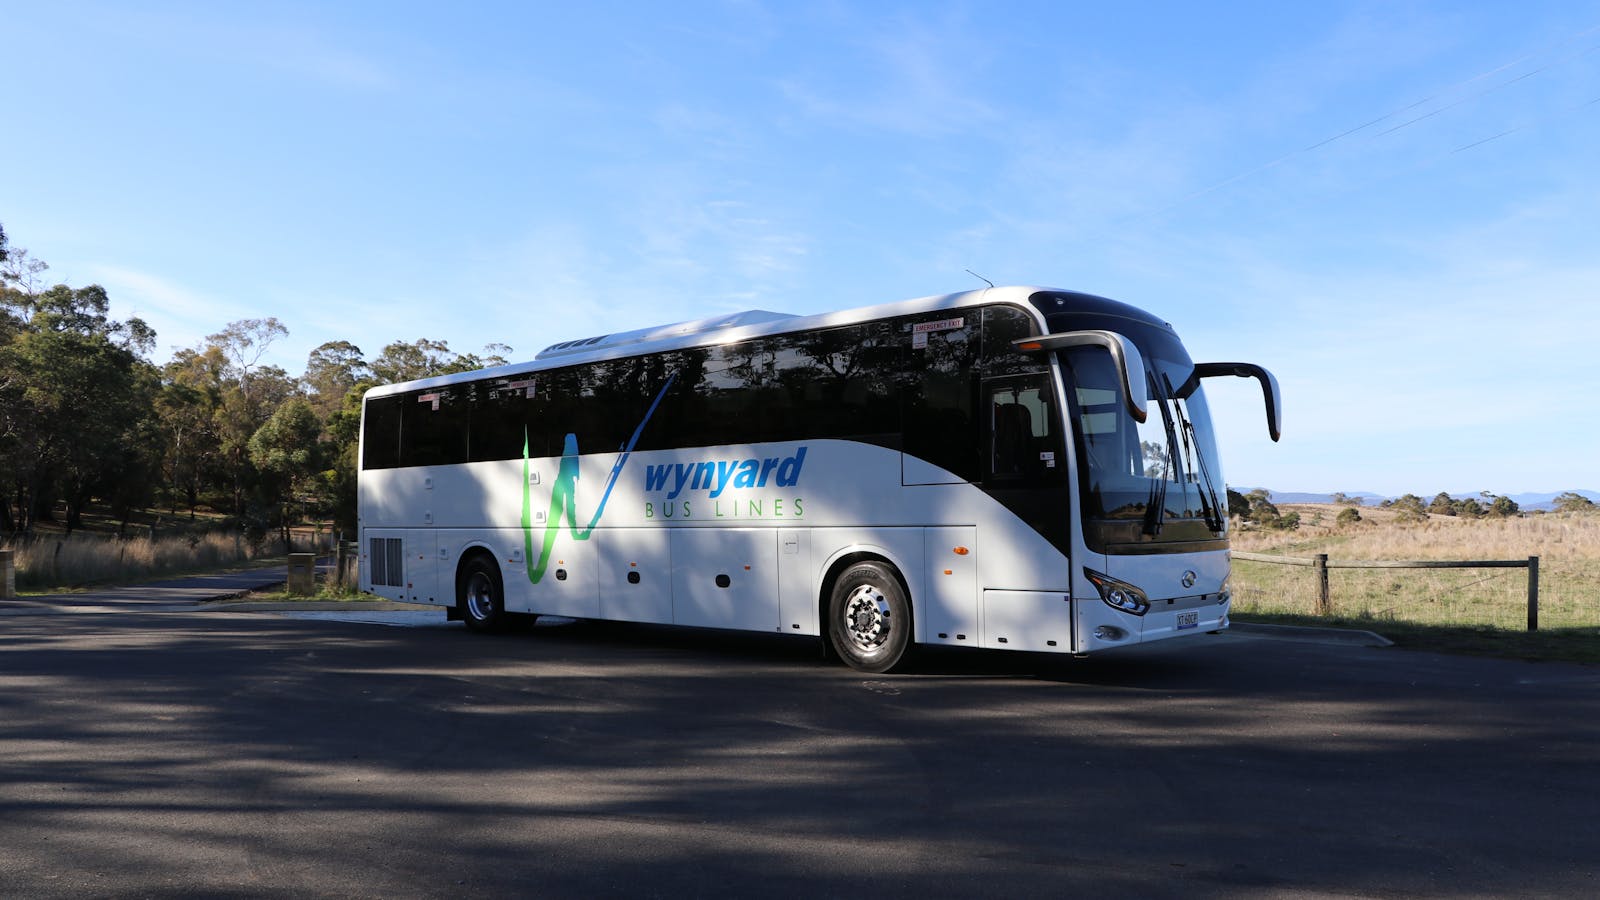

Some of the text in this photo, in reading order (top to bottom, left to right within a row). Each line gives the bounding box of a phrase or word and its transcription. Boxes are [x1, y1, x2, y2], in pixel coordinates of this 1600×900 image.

[948, 319, 961, 327] EXIT
[645, 446, 808, 500] wynyard
[645, 498, 805, 518] BUS LINES
